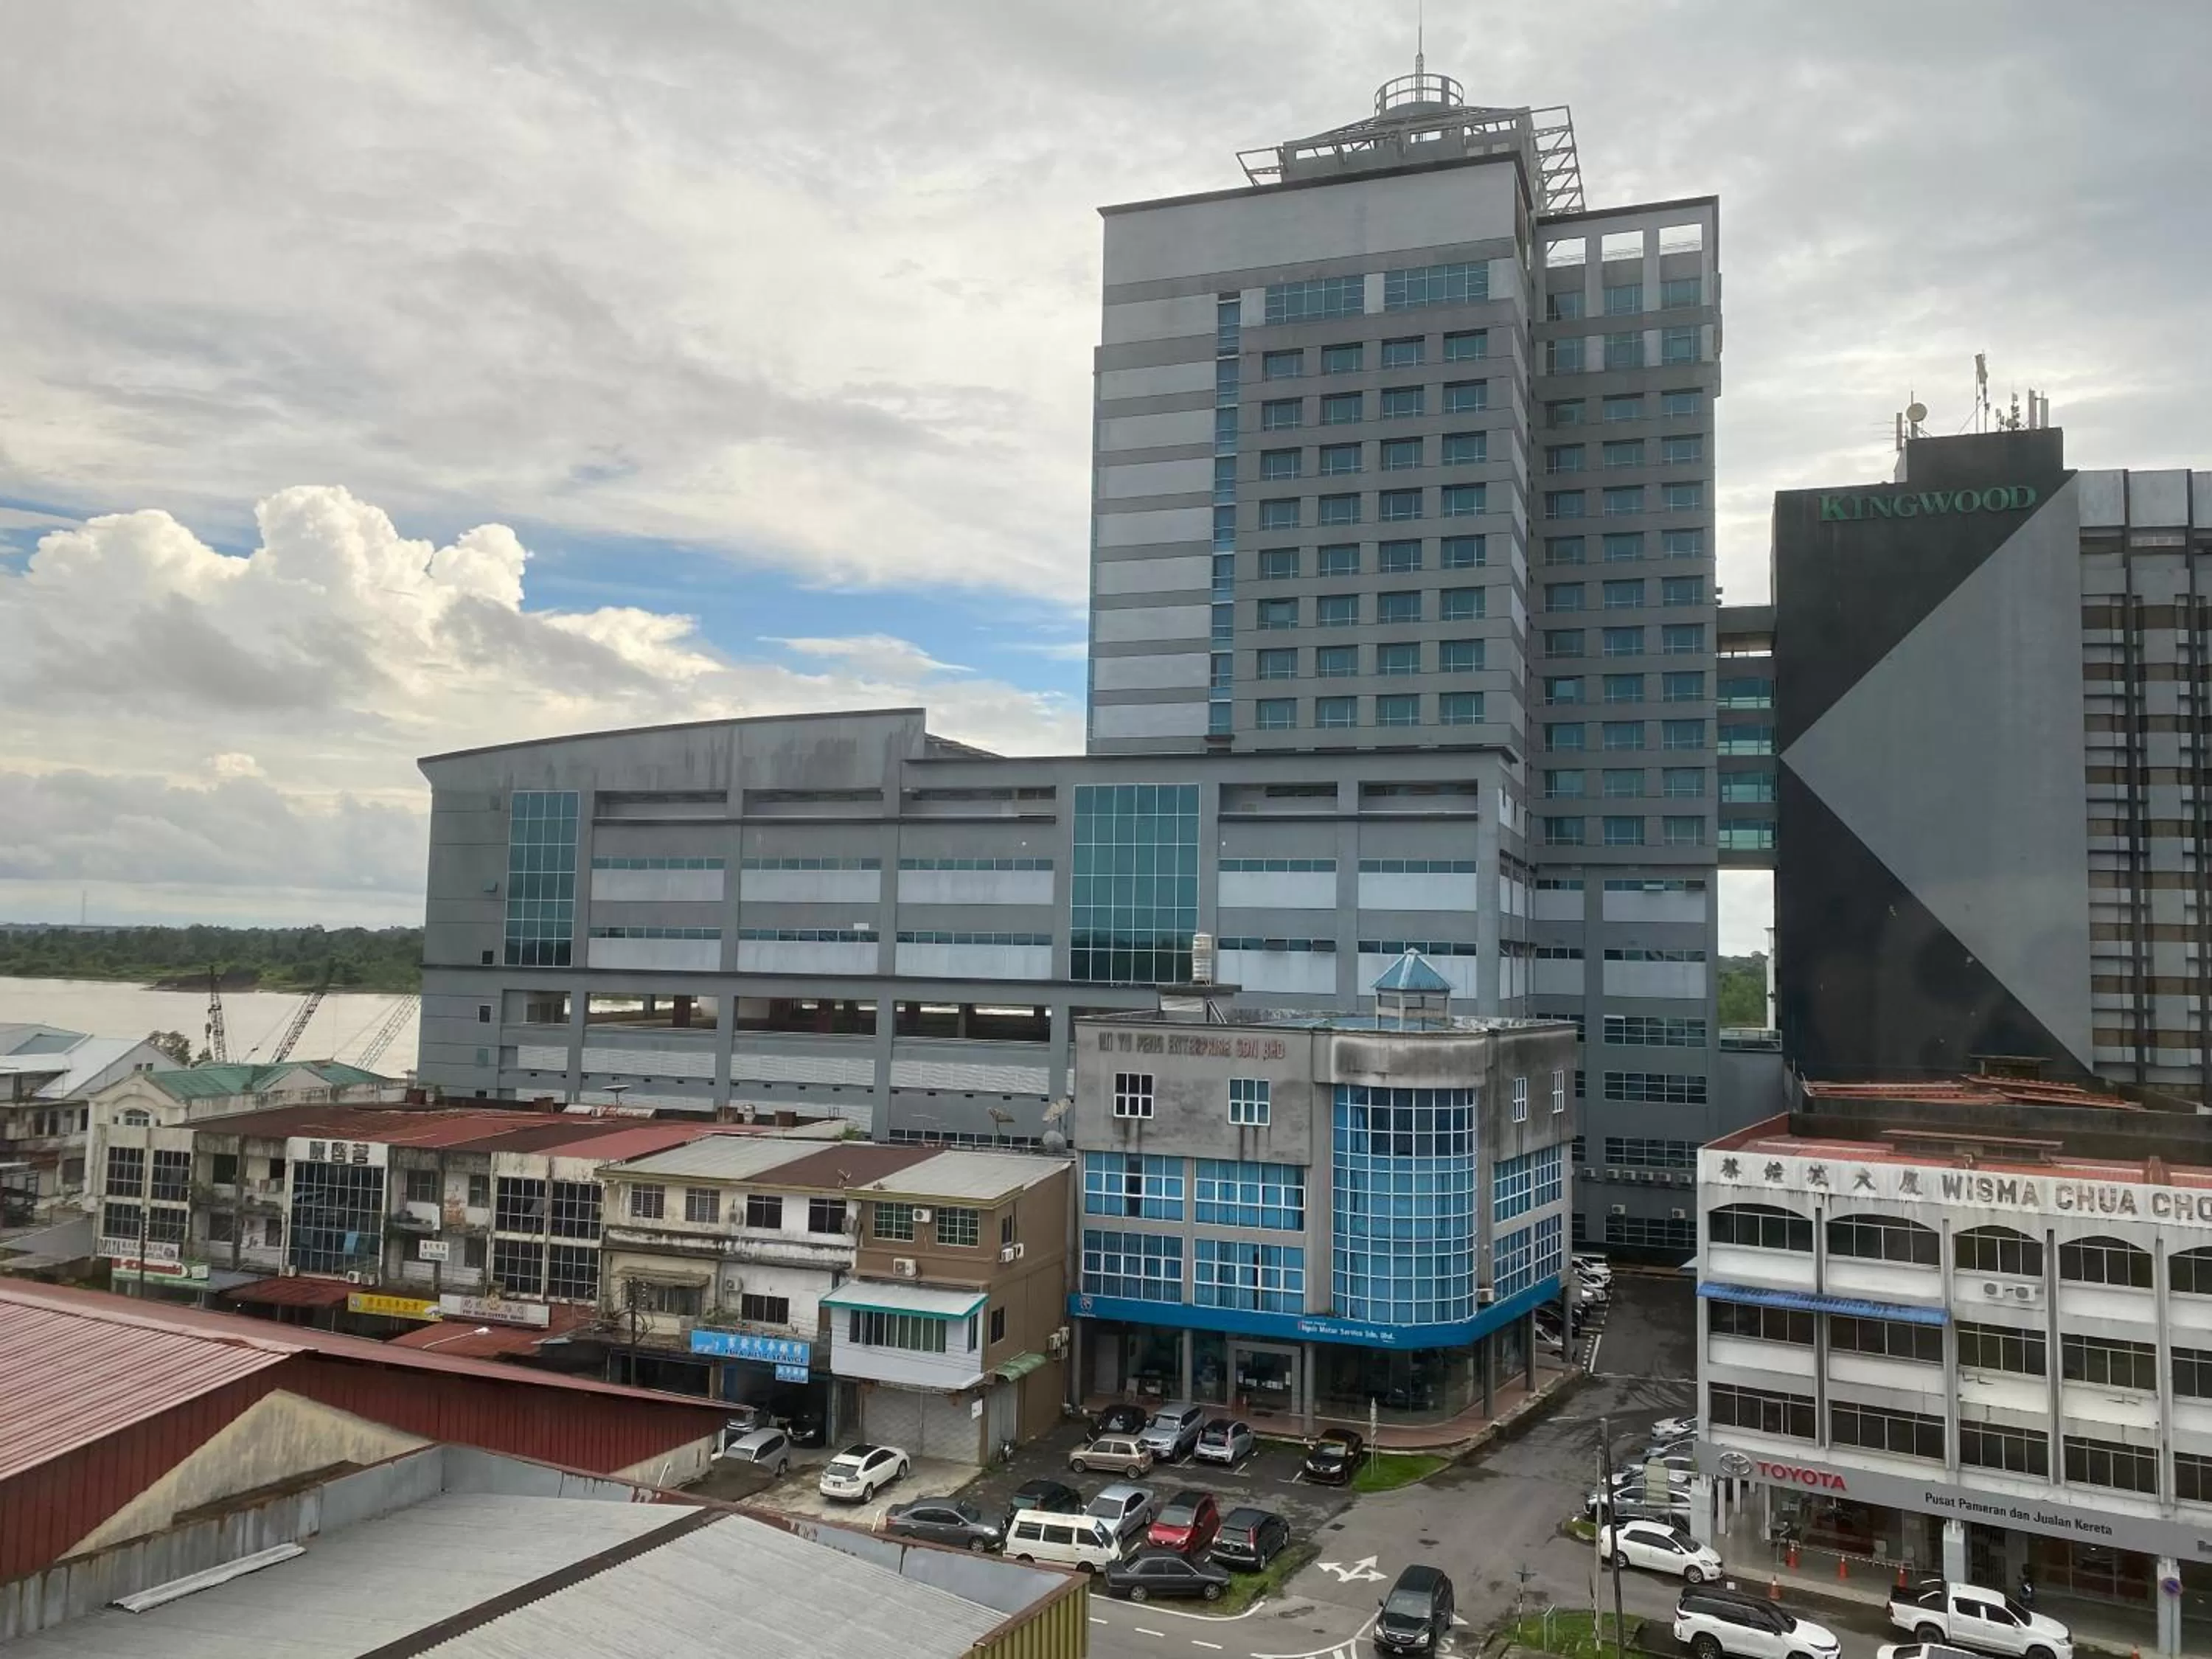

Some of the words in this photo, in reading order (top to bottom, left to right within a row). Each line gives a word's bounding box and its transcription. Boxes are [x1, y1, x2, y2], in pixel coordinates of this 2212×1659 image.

[1819, 485, 2037, 521] KINGWOOD
[1237, 1037, 1258, 1060] SDN
[1263, 1038, 1286, 1060] BHD
[1941, 1173, 2040, 1207] WISMA
[2055, 1183, 2138, 1216] CHUA
[1340, 1328, 1363, 1337] Service
[1756, 1459, 1847, 1491] TOYOTA
[1925, 1492, 1955, 1508] Pusat
[1959, 1498, 2006, 1517] Pameran
[2010, 1506, 2029, 1521] dan
[2034, 1512, 2071, 1528] Jualan
[2075, 1519, 2112, 1536] Kereta
